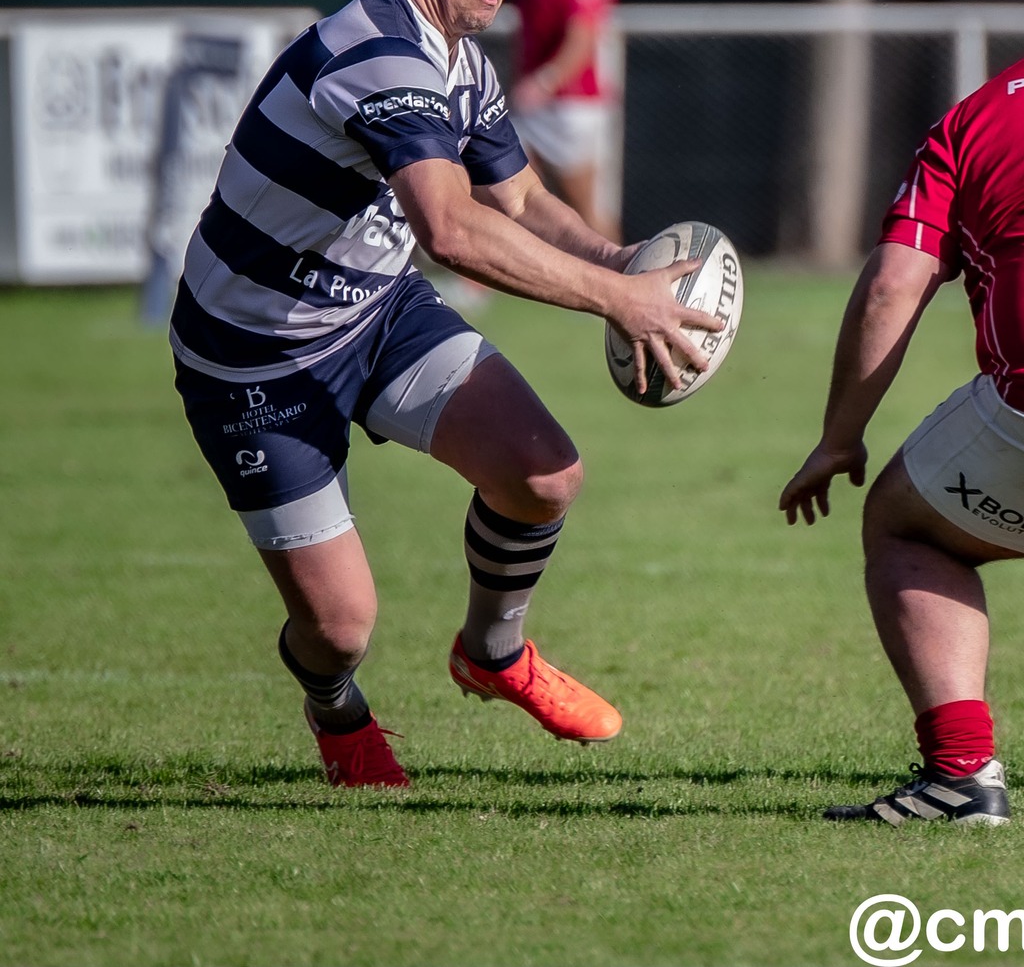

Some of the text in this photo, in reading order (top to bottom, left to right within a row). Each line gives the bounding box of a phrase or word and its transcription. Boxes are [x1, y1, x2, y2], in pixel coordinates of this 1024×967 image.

[290, 258, 319, 289] La
[679, 253, 737, 392] GILET
[222, 402, 307, 434] BICENTENARIO
[241, 404, 277, 420] HOTEL
[240, 465, 268, 478] quince
